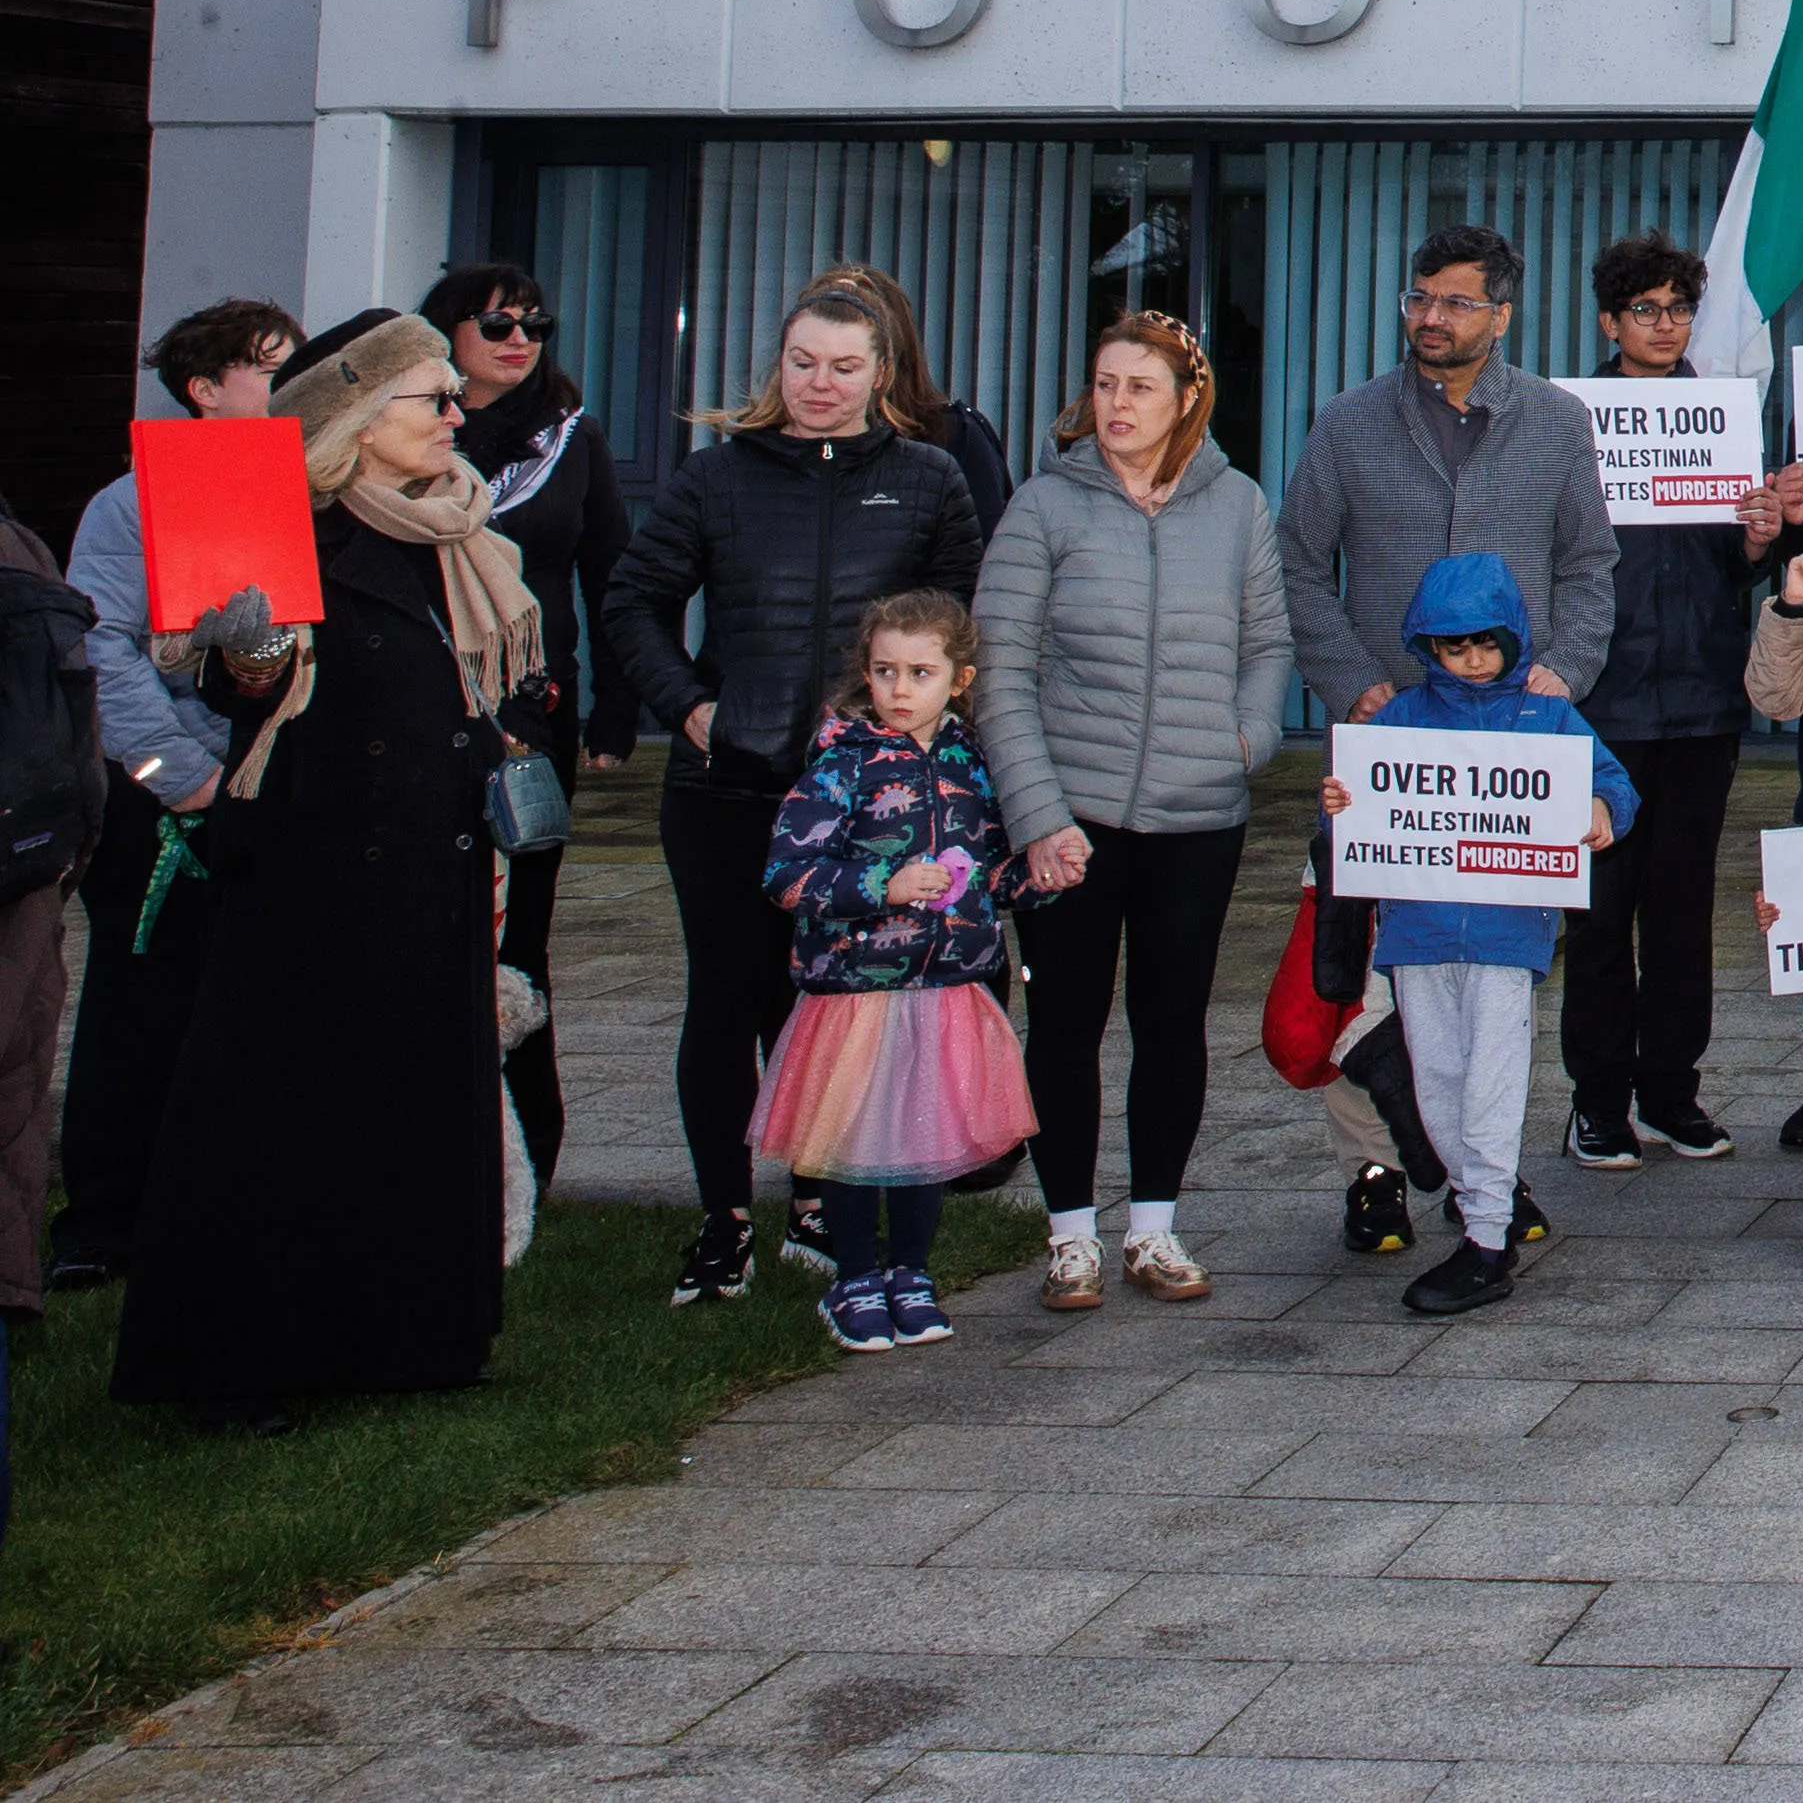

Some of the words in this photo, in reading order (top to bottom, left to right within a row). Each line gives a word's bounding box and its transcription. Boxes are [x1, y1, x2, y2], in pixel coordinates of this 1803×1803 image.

[1587, 406, 1648, 435] VER
[1656, 406, 1726, 438] 1,000
[1371, 761, 1457, 796] OVER
[1467, 766, 1551, 801] 1,000
[1390, 809, 1531, 835] PALESTINIAN
[1344, 842, 1454, 866] ATHLETES
[1460, 846, 1576, 873] MURDERED
